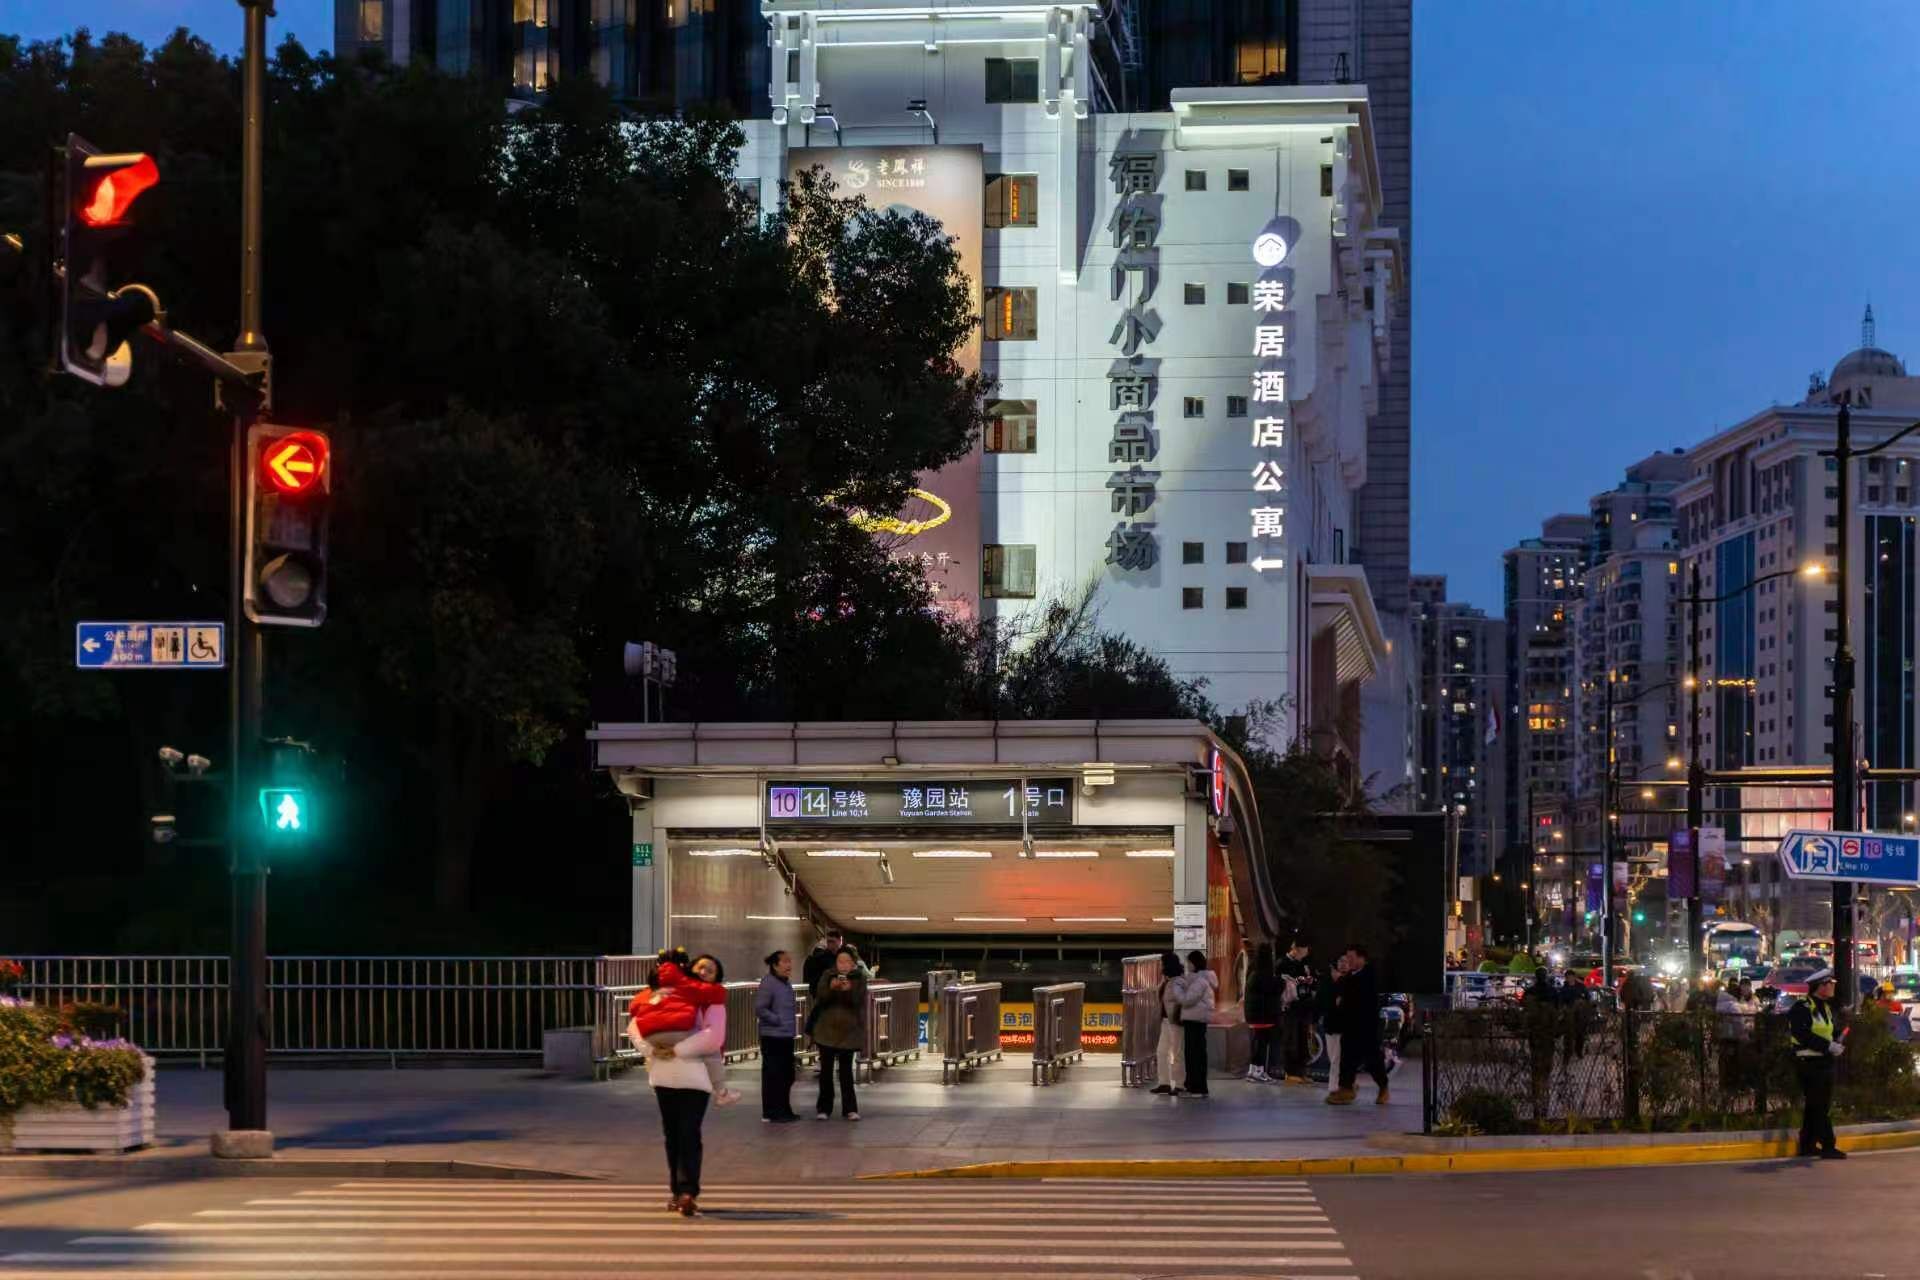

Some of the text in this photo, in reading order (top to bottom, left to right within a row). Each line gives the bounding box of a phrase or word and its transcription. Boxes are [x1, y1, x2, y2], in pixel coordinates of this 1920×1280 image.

[1106, 154, 1157, 571] 福佑门小商品市场
[1251, 280, 1285, 538] 荣居酒店公寓
[774, 792, 827, 812] 10 14
[832, 791, 867, 808] 号线
[903, 787, 969, 808] 豫园站
[832, 809, 847, 817] Line
[1866, 843, 1880, 856] 10
[1885, 844, 1905, 856] 号线
